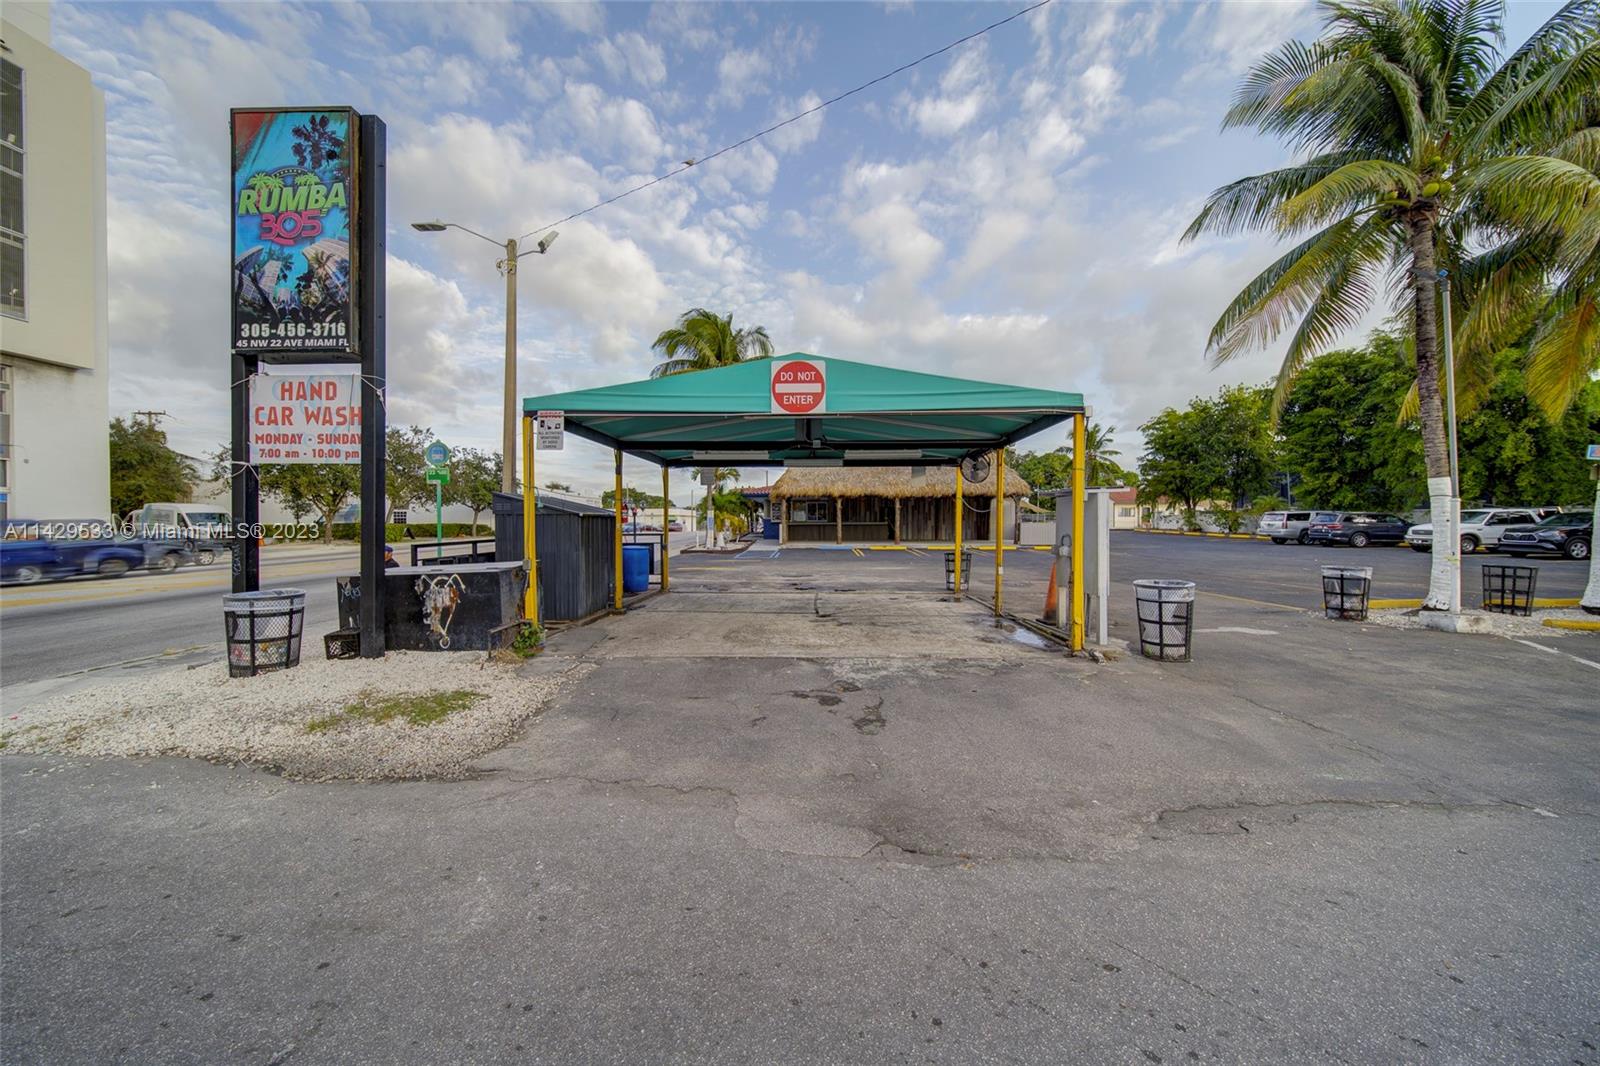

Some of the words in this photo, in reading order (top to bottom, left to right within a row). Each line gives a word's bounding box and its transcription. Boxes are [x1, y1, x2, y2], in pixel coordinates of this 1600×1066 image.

[238, 182, 347, 216] RUMBA
[261, 209, 322, 245] 305
[241, 322, 346, 337] 305-456-3716
[304, 339, 336, 347] MIAMI
[781, 372, 793, 381] DO
[797, 372, 816, 381] NOT
[281, 381, 337, 401] HAND
[783, 395, 814, 404] ENTER
[255, 406, 294, 426] CAR
[304, 406, 362, 426] WASH
[255, 433, 303, 445] MONDAY
[316, 433, 362, 445] SUNDAY
[259, 449, 281, 458] 7:00
[312, 449, 341, 458] 10:00
[345, 450, 360, 460] pm
